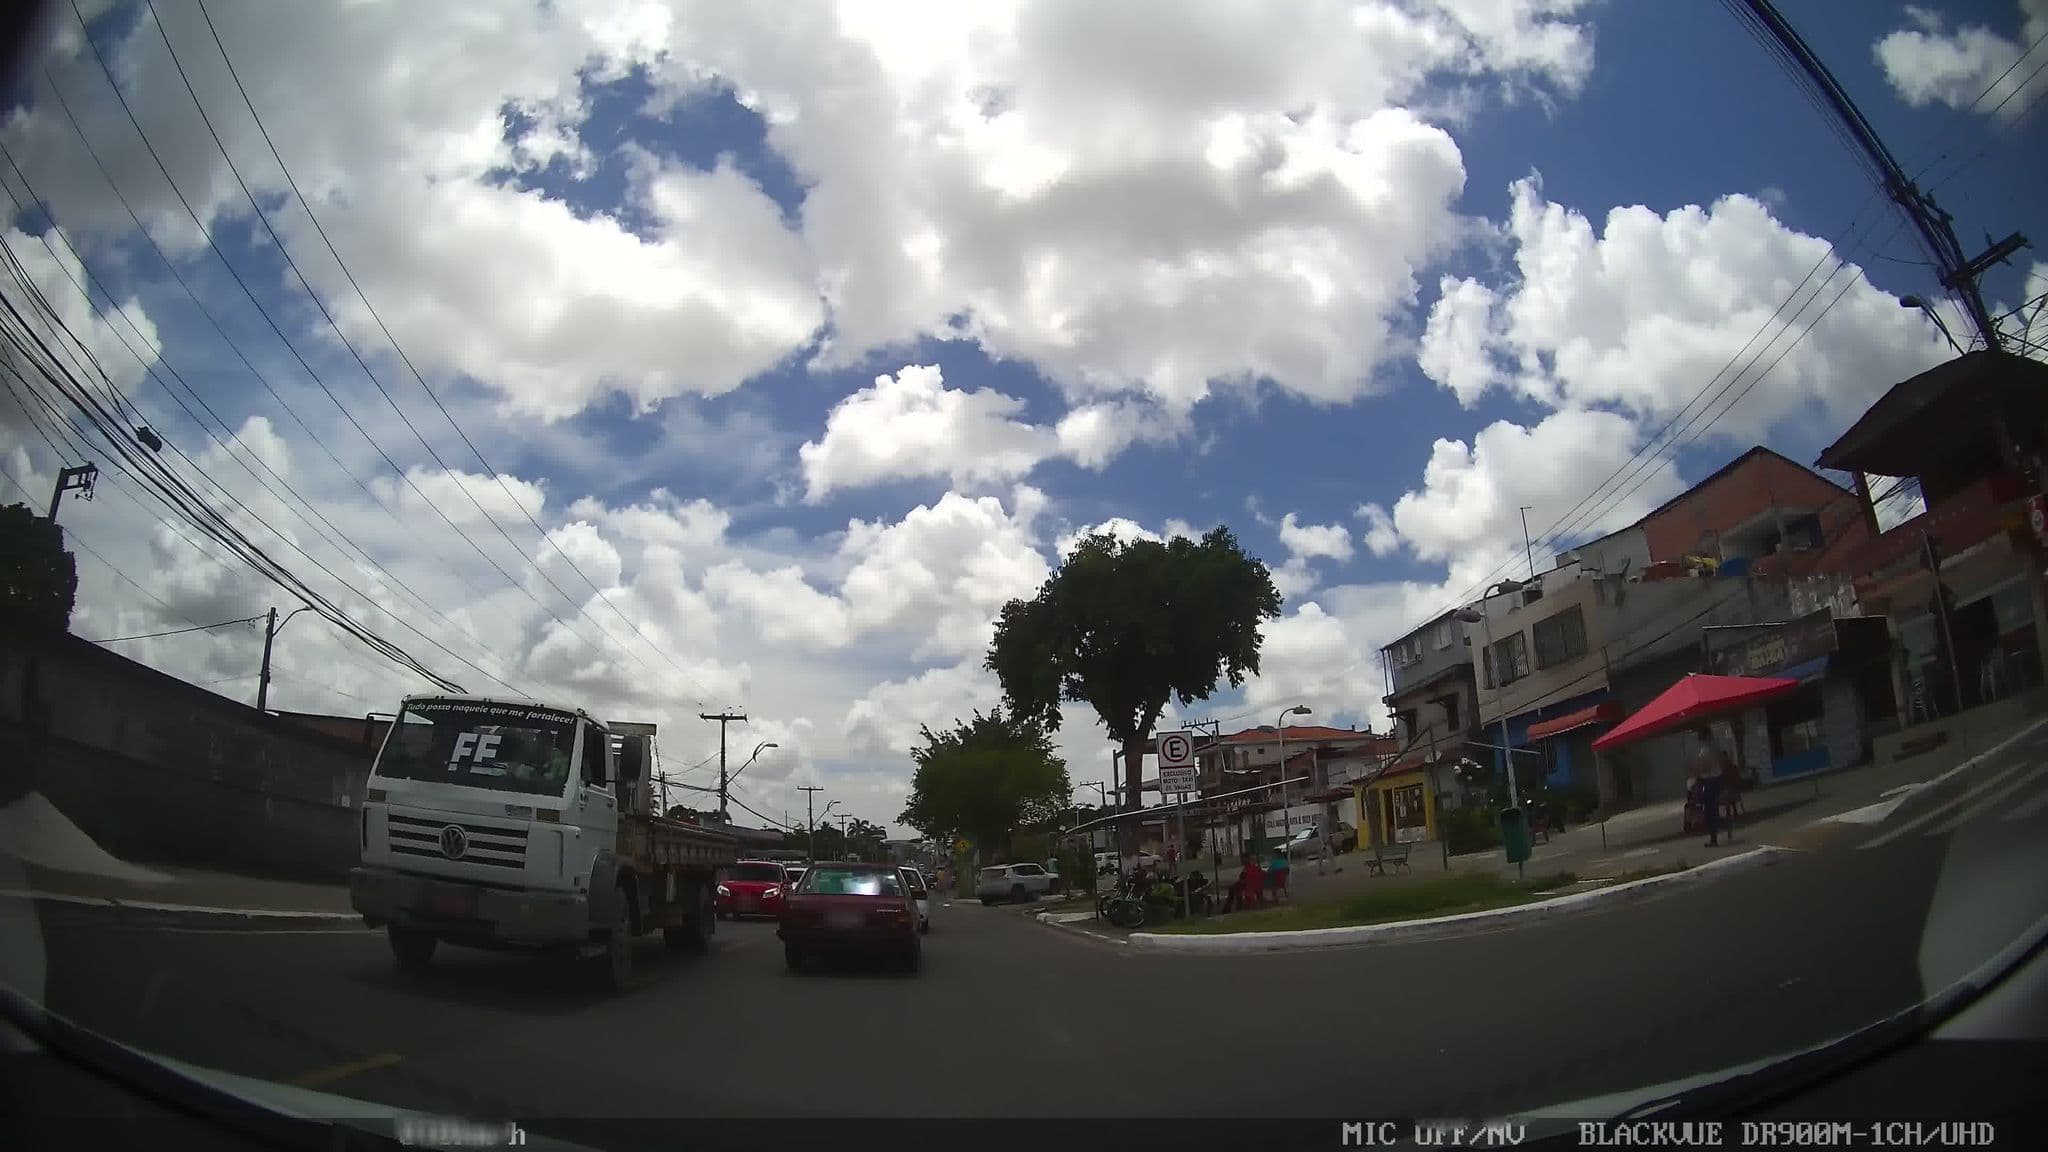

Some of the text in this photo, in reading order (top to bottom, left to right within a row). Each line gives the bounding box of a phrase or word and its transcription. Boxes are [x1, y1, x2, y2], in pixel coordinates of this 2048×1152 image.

[452, 705, 489, 714] naquele
[490, 707, 507, 716] que
[1170, 741, 1182, 757] E
